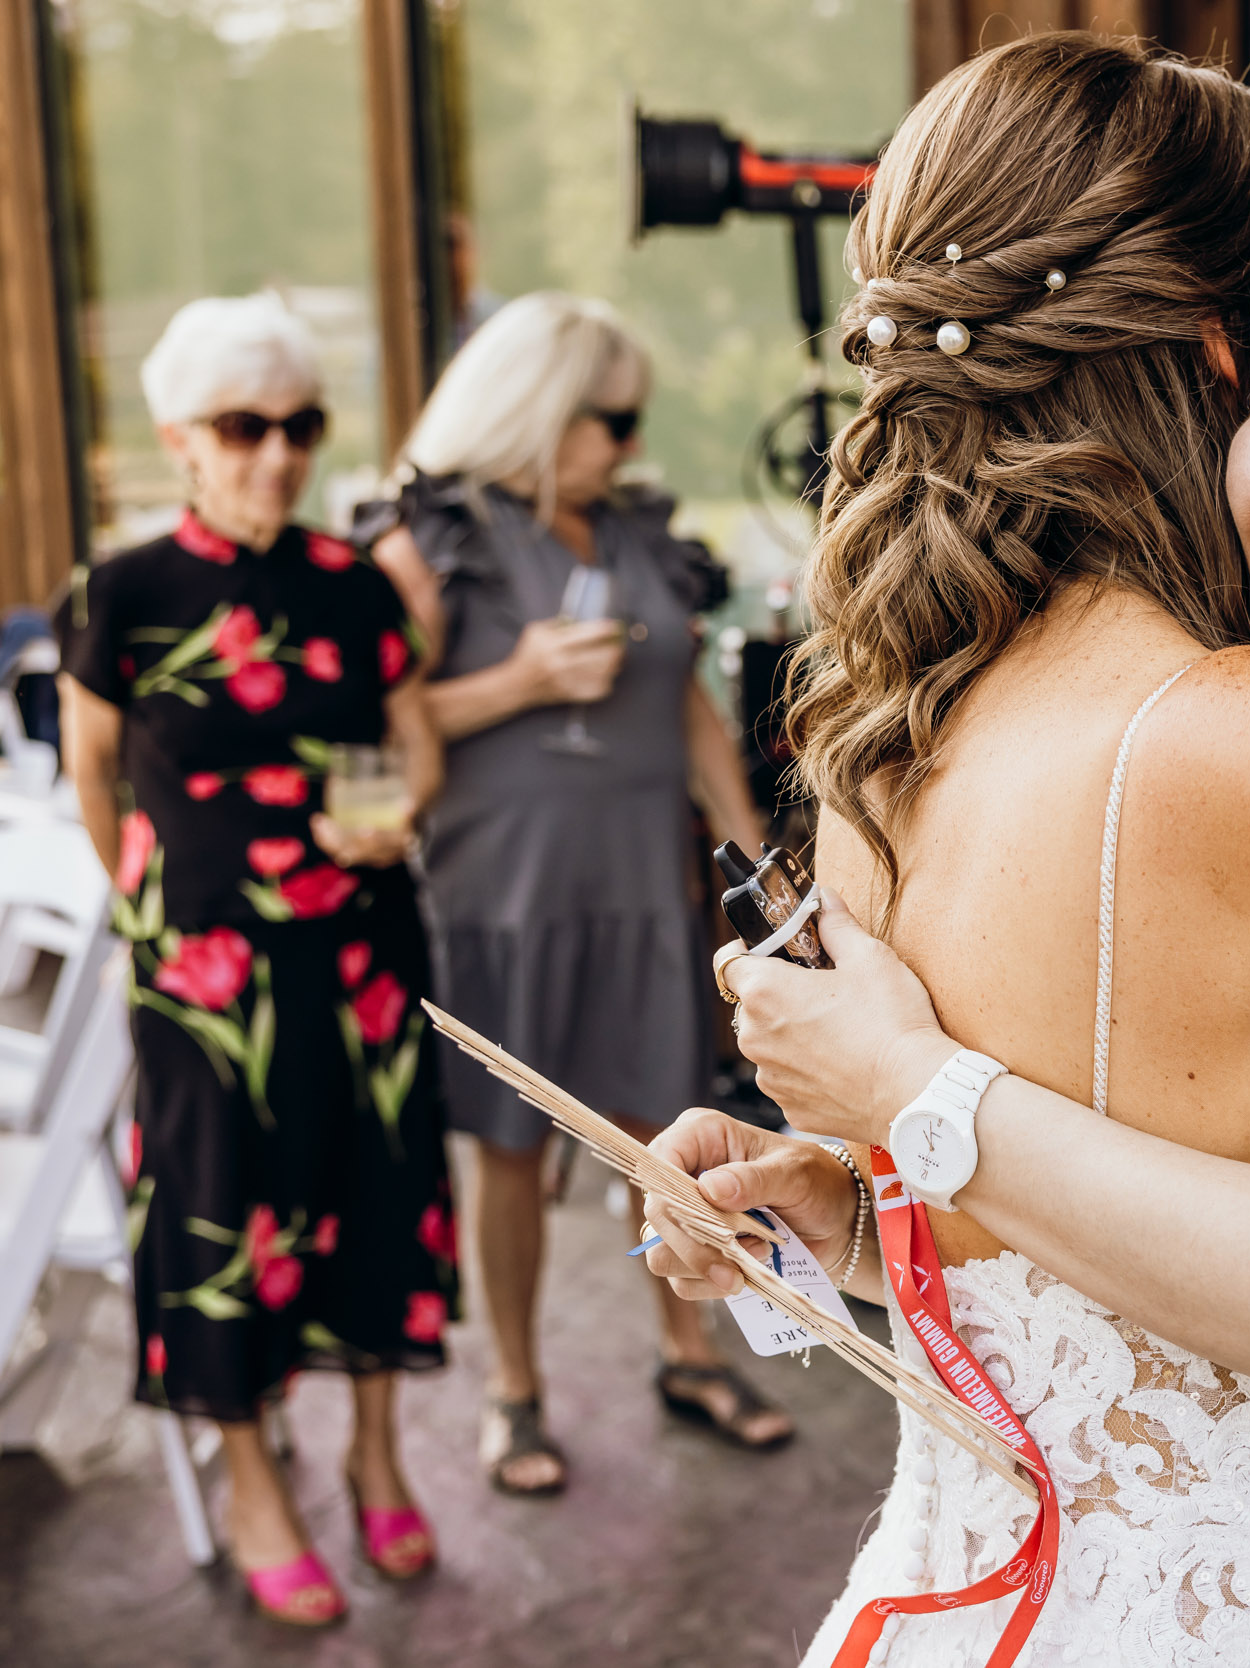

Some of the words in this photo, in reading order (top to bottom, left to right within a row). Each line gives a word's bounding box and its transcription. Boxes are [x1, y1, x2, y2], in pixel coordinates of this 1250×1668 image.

[781, 1258, 808, 1268] photo
[909, 1308, 960, 1364] GUMMY
[947, 1358, 1027, 1449] WATERMELON
